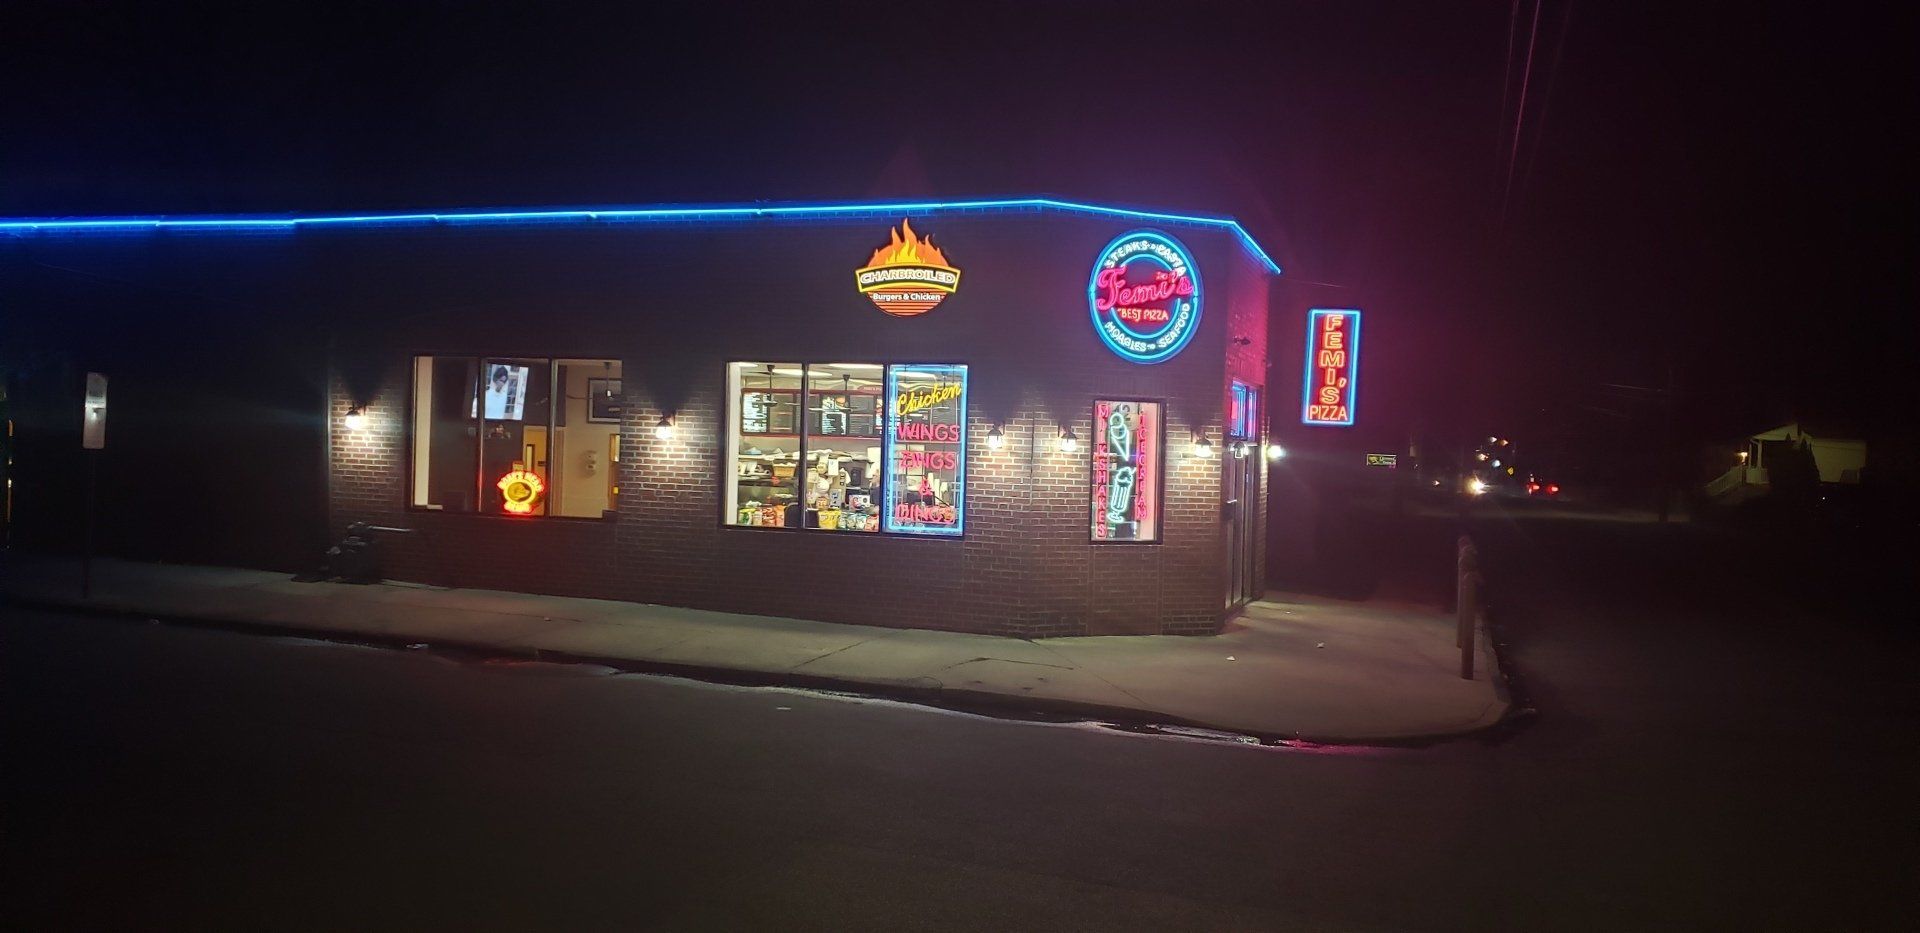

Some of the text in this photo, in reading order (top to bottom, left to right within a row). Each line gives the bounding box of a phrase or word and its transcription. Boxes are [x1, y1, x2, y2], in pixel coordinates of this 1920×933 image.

[1104, 240, 1148, 268] STEAKS
[860, 268, 956, 284] CHARBROILED
[872, 292, 941, 302] Burgers & Chicken
[1096, 265, 1194, 311] Femi's
[1143, 309, 1169, 321] PIZZA
[1158, 302, 1191, 348] SEAFOOD
[1319, 314, 1347, 404] FEMI'S
[896, 382, 962, 416] Chicken
[1309, 405, 1348, 421] PIZZA
[897, 423, 960, 441] WINGS
